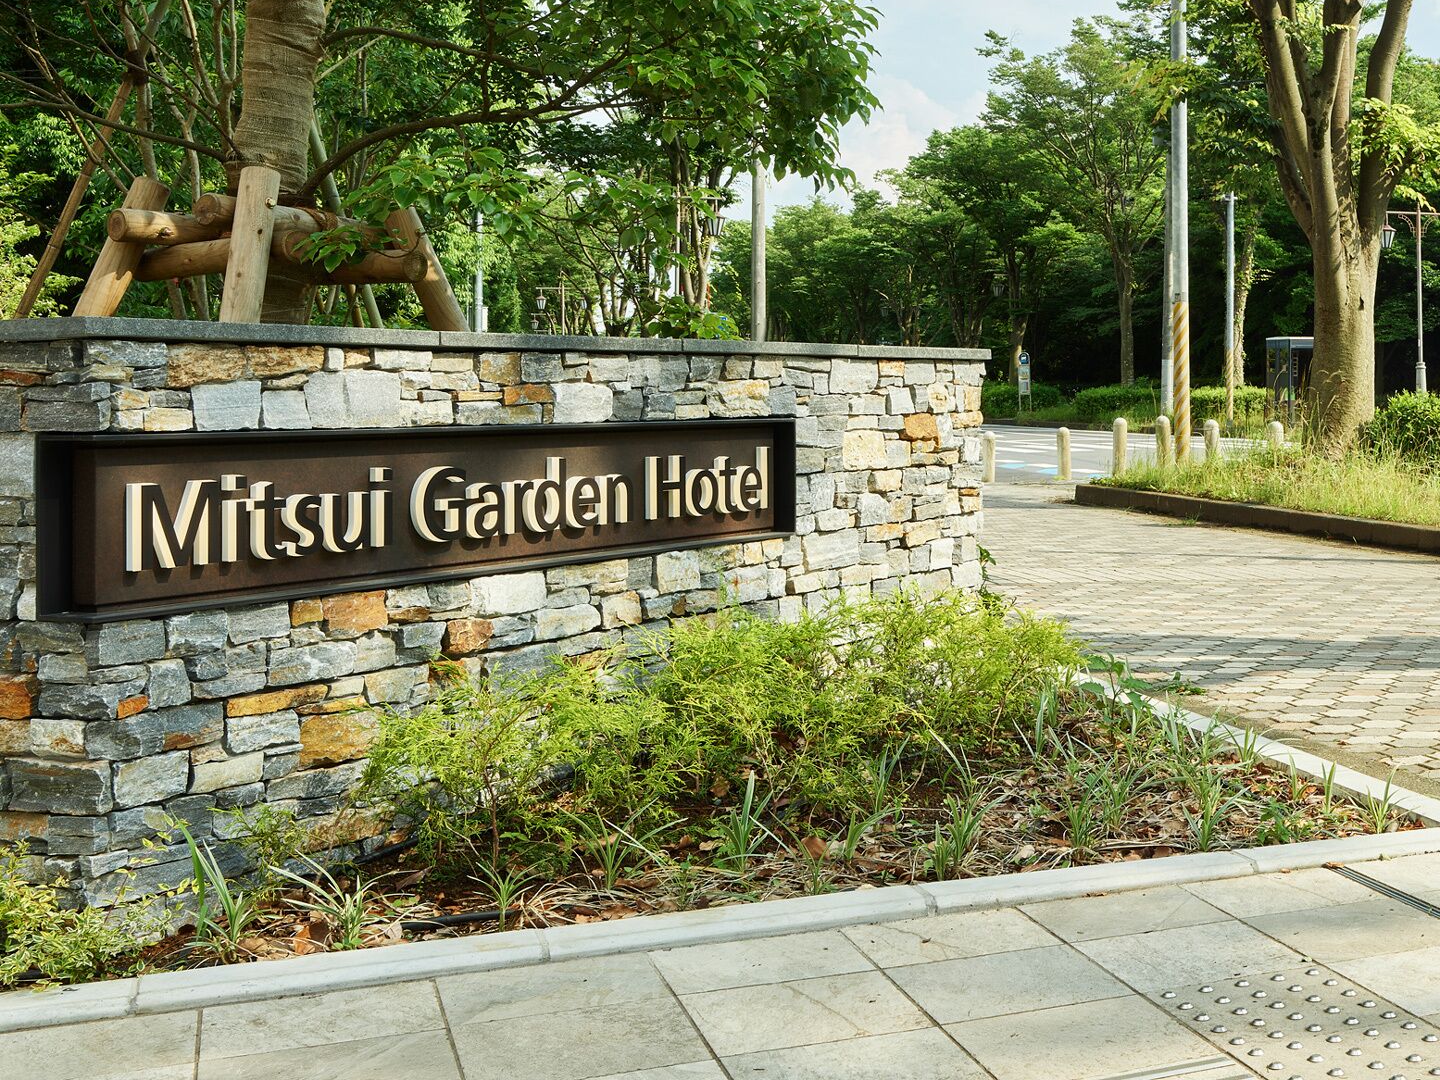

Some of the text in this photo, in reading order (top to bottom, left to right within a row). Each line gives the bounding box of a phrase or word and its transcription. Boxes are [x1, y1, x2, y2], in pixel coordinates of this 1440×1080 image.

[125, 446, 771, 572] Mitsui Garden Hotel
